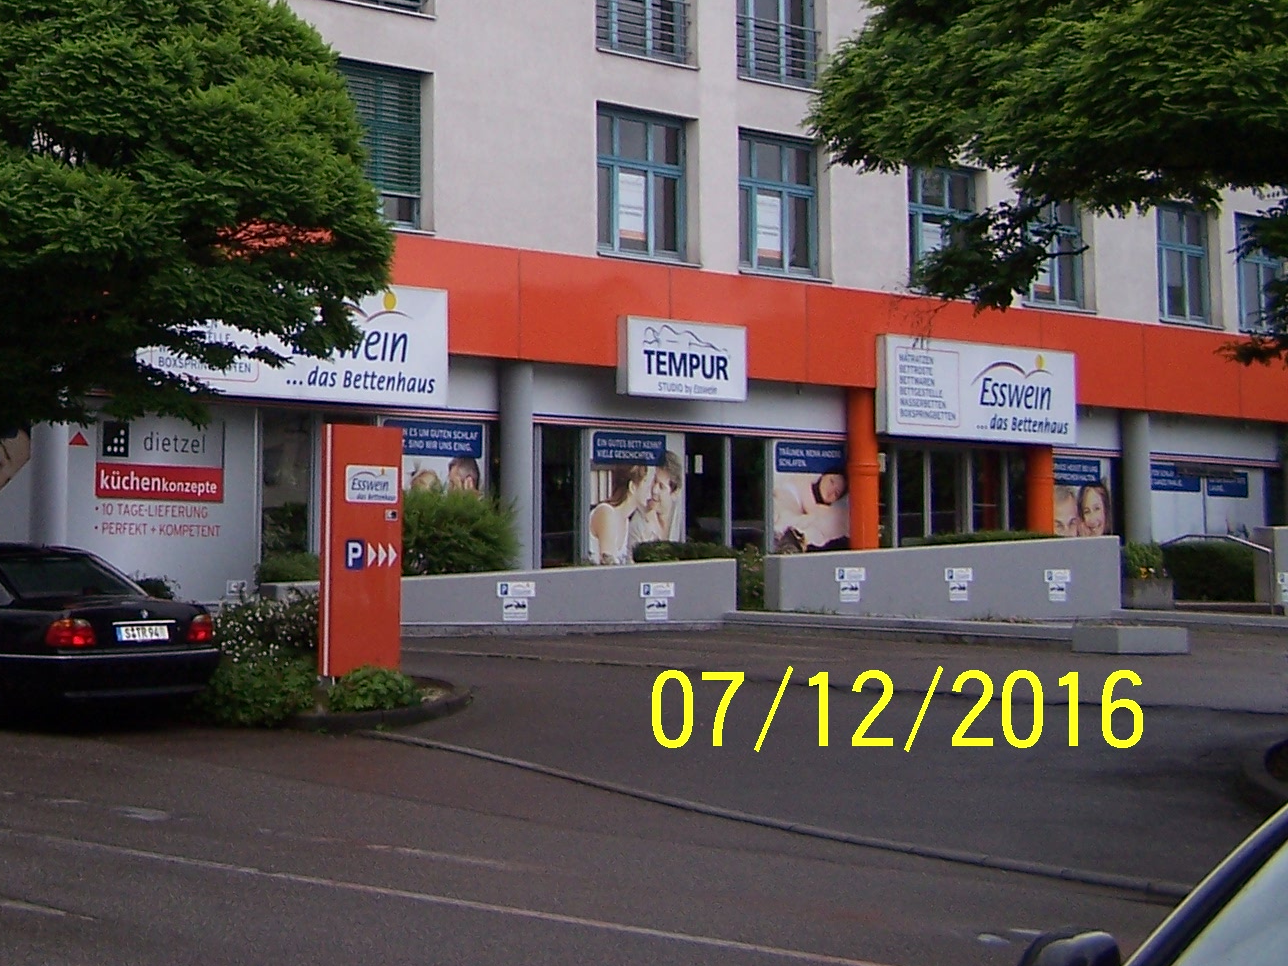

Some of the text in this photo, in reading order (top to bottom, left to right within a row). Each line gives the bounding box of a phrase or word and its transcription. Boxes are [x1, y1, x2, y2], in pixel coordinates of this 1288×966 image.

[643, 350, 728, 380] TEMPUR
[343, 370, 436, 394] Bettenhaus
[658, 382, 683, 393] STUDIO
[980, 377, 1052, 411] Esswein
[409, 428, 418, 437] ES
[430, 429, 451, 439] GUTEN
[453, 431, 478, 440] SCHLAF
[1011, 416, 1069, 435] Bettenhaus
[143, 431, 206, 453] dietzel
[408, 440, 424, 449] SIND
[425, 441, 437, 449] WIR
[438, 442, 452, 450] UNS
[627, 439, 641, 448] BETT
[100, 469, 217, 496] küchenkonzepte
[351, 477, 389, 491] Esswein
[102, 503, 208, 518] 10 TAGE-LIEFERUNG
[102, 522, 147, 535] PERFEKT
[159, 524, 221, 537] KOMPETENT
[348, 542, 362, 567] P
